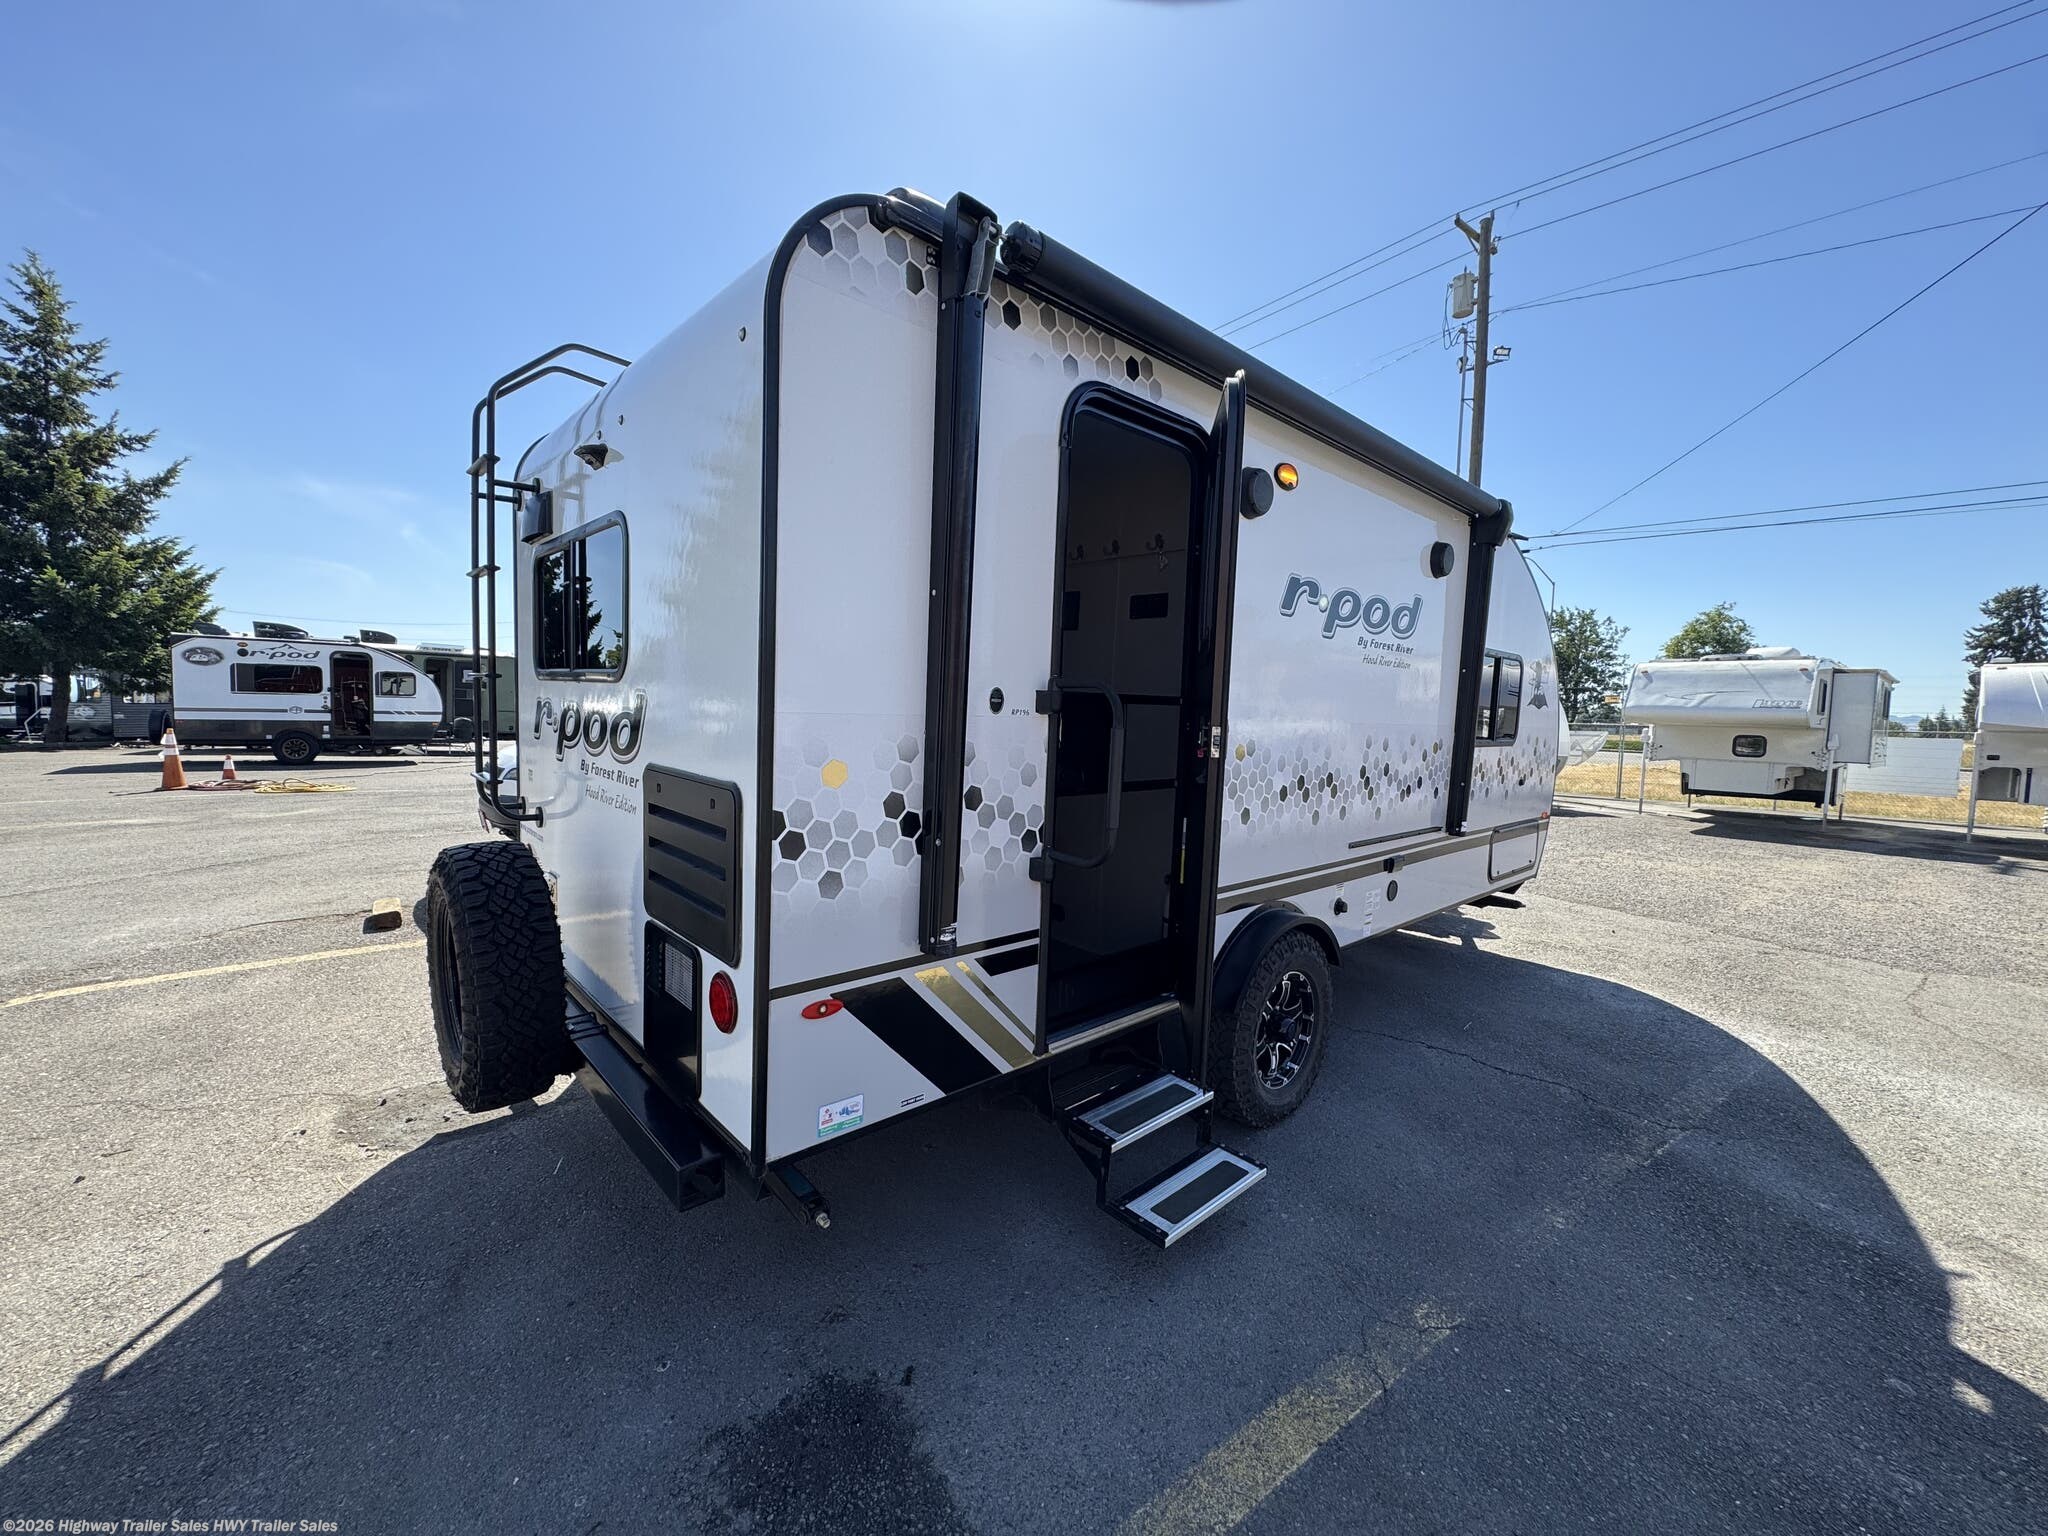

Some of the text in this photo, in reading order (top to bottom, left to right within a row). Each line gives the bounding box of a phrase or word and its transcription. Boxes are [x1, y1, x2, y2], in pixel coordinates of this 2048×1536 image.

[1357, 636, 1414, 655] By Forest River
[1362, 653, 1411, 669] Hood River Edition
[580, 759, 640, 788] By Forest River
[585, 784, 637, 815] Hood River Edition
